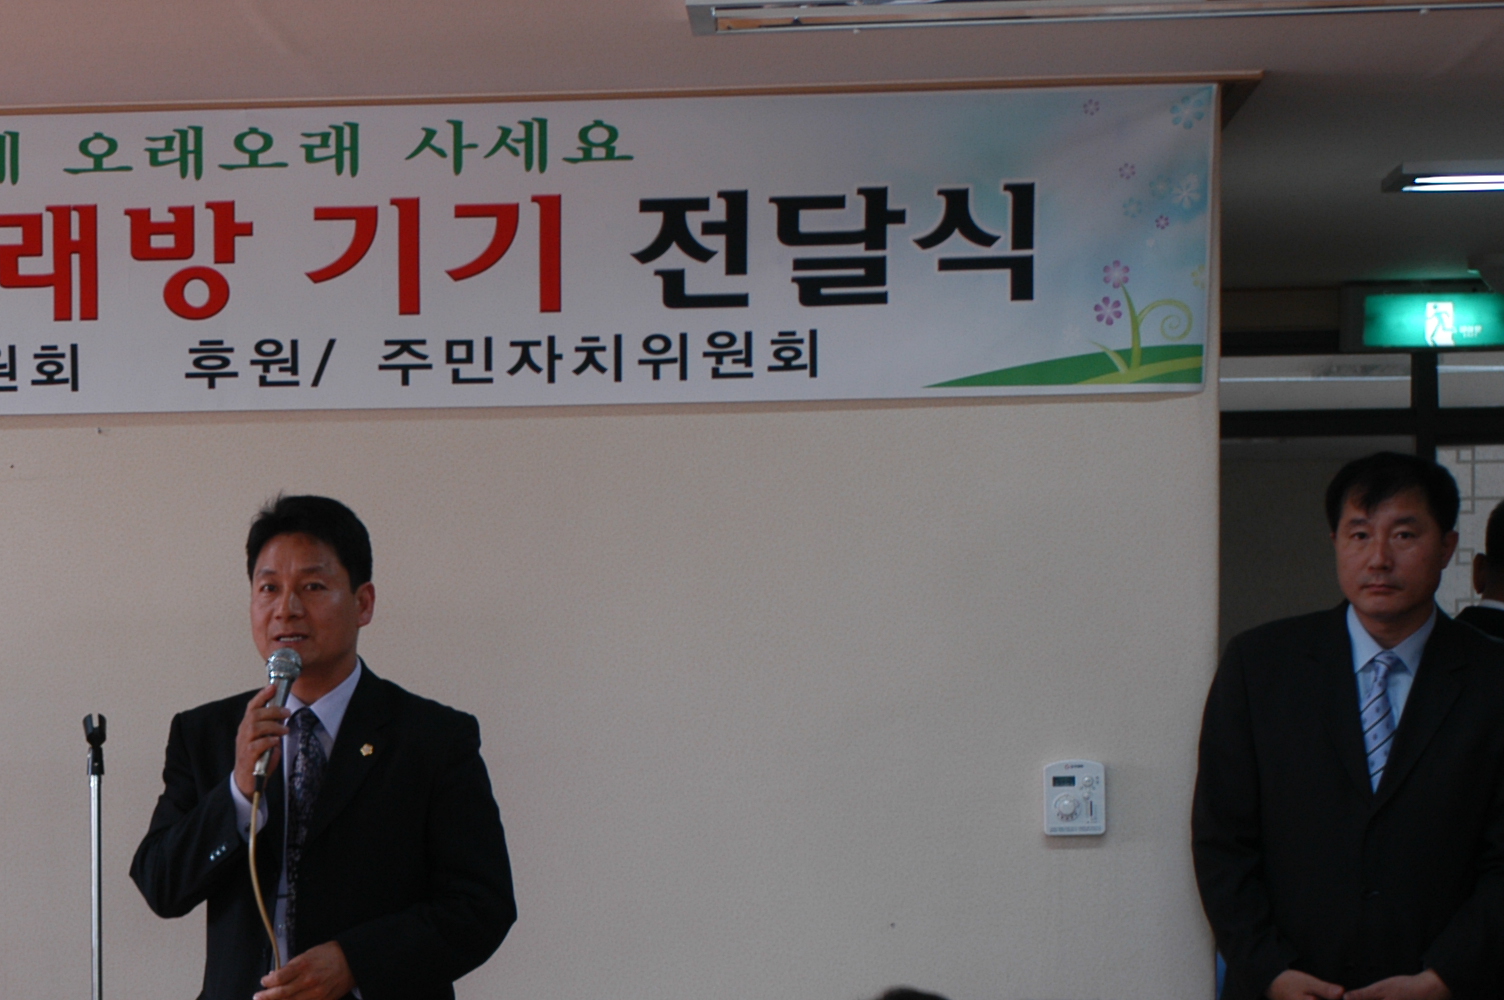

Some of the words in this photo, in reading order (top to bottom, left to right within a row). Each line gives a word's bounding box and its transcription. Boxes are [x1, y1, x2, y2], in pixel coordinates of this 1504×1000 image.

[63, 122, 360, 183] 오래오래
[404, 117, 635, 177] 사세요
[304, 194, 563, 316] 기기
[629, 181, 1036, 310] 전달식
[184, 337, 337, 390] 후원/
[377, 328, 819, 388] 주민자치위원회
